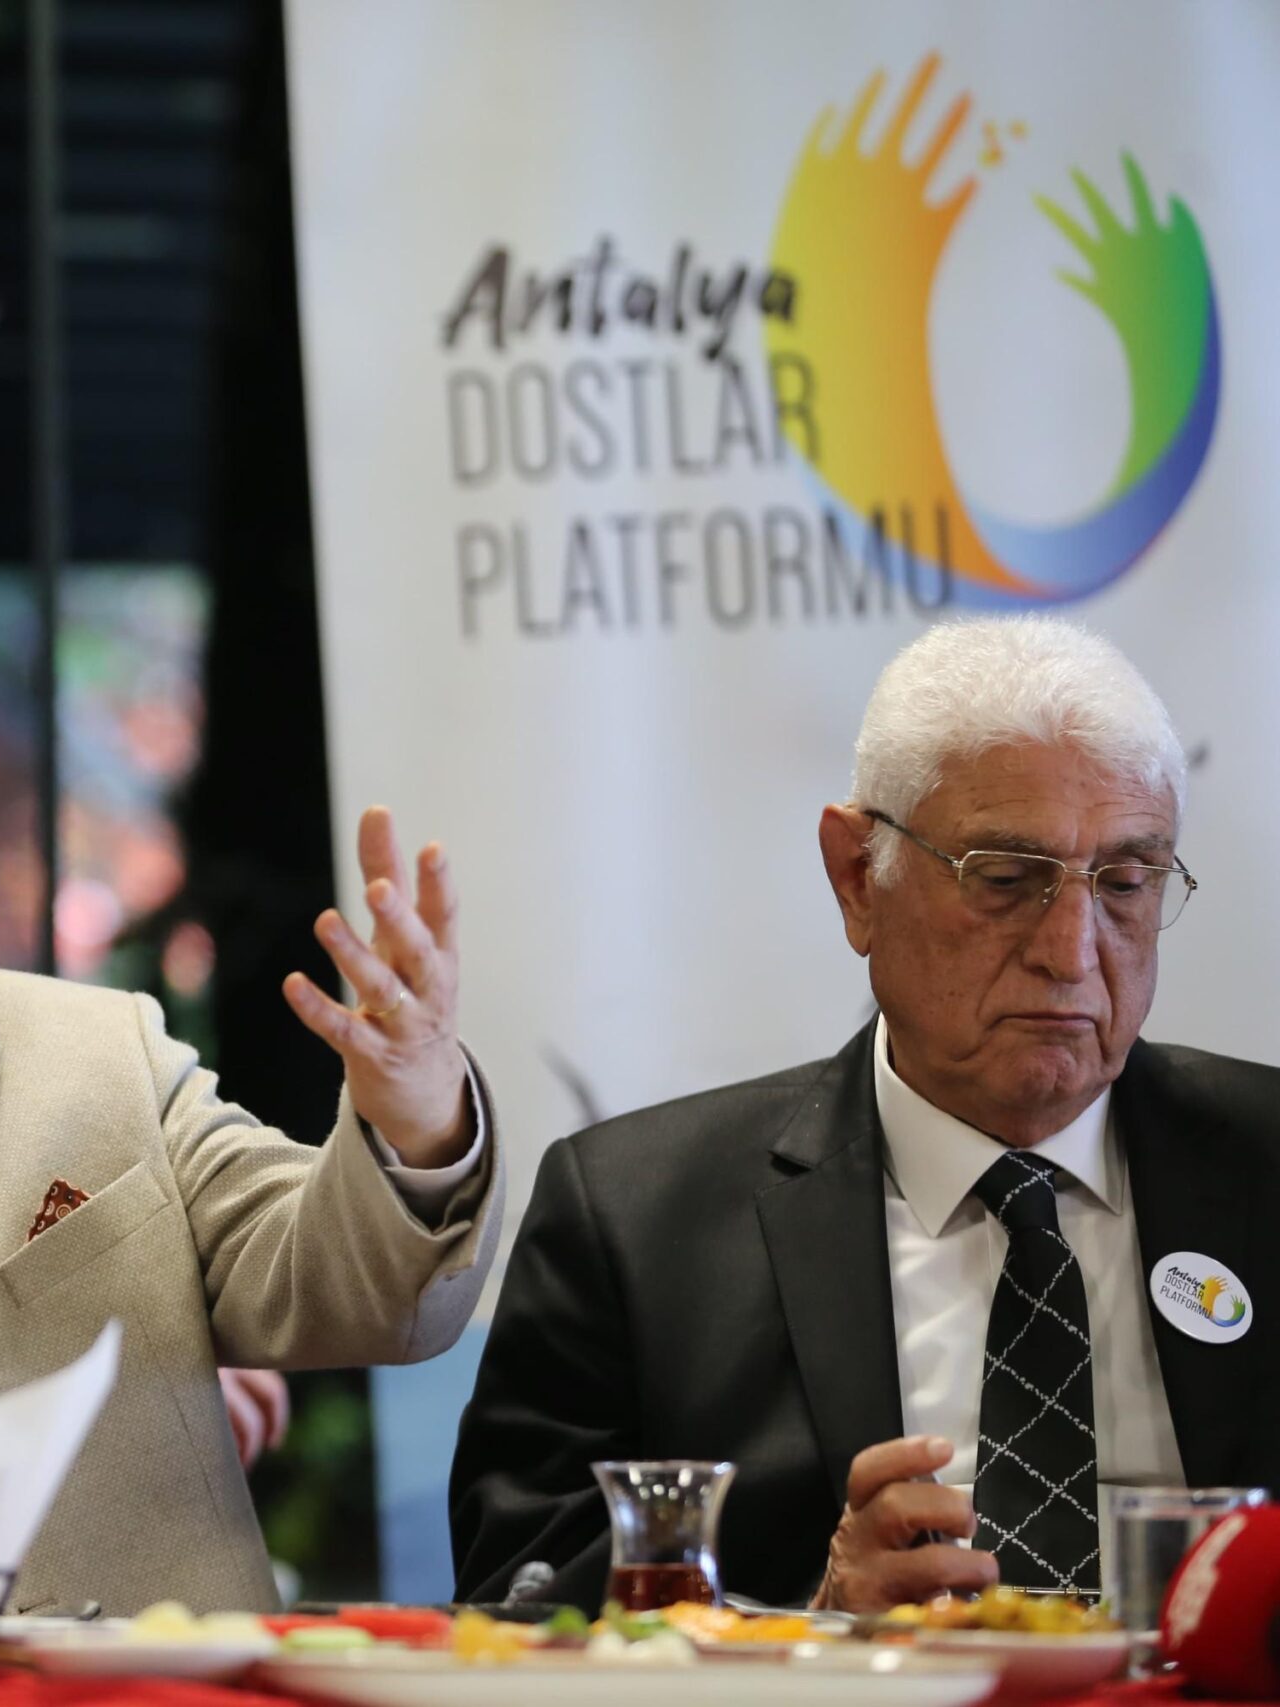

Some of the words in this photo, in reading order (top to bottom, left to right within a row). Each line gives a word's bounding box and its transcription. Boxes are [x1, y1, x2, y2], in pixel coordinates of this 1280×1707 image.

[442, 234, 799, 362] Antalya
[447, 350, 820, 488] DOSTLAR
[456, 498, 952, 642] PLATFORMU
[1160, 1285, 1213, 1319] PLATFORMU
[1165, 1273, 1205, 1300] DOSTLAR
[1168, 1266, 1206, 1290] Antalya
